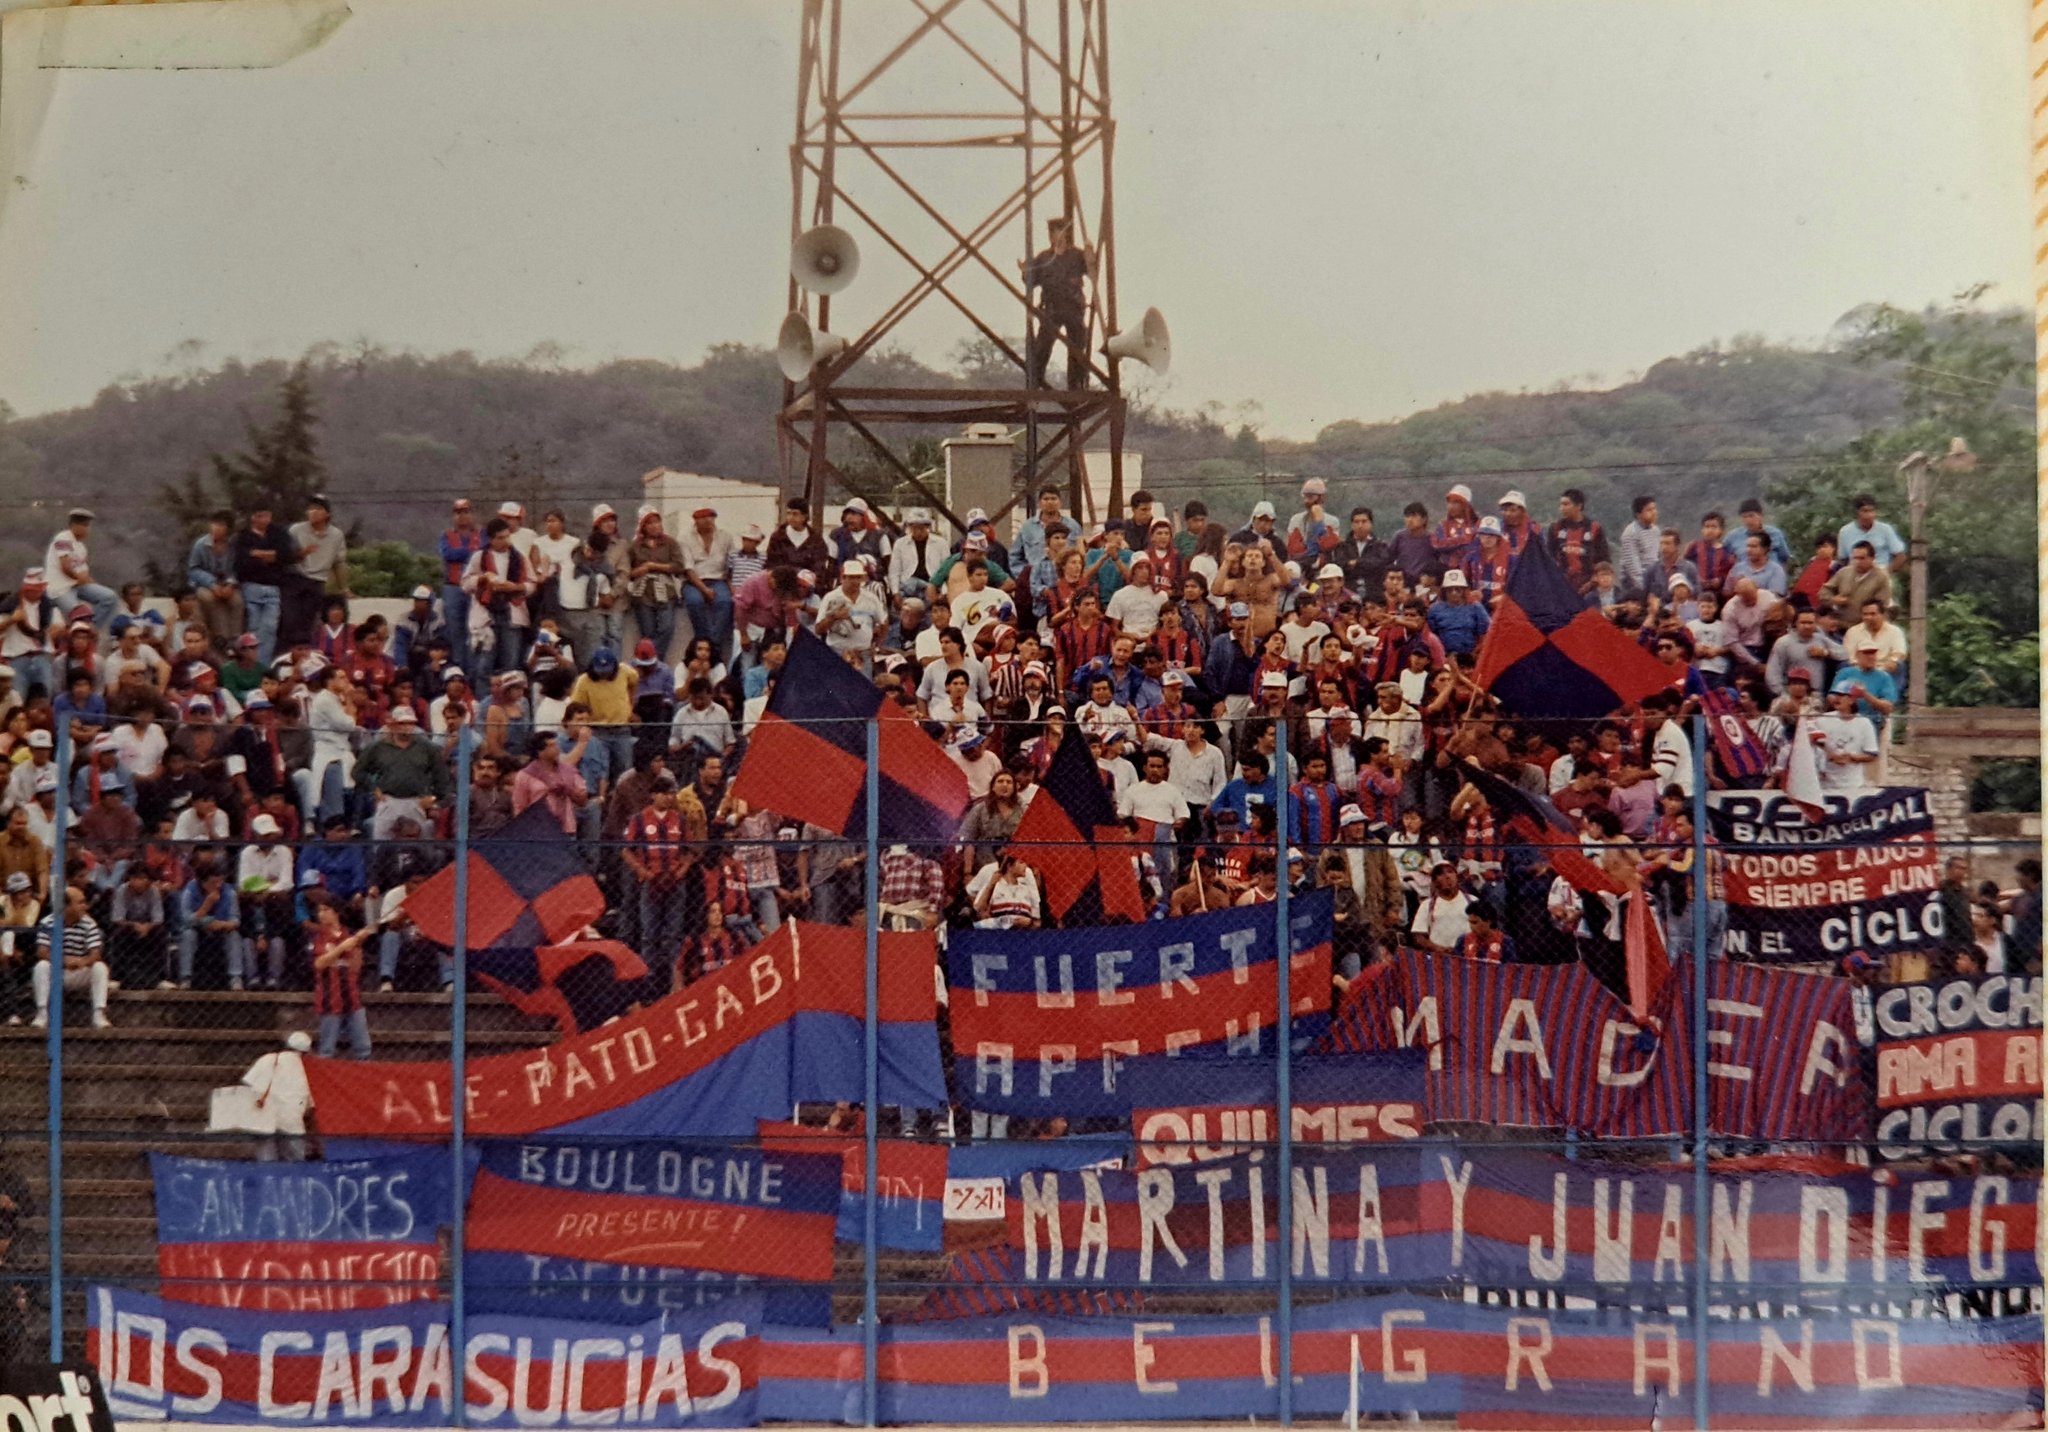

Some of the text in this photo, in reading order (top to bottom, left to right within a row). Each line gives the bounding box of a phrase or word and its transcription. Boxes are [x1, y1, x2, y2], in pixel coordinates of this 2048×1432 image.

[1726, 833, 1924, 879] TODOS LADOS
[1733, 822, 1843, 844] BANDA
[1761, 931, 1792, 954] EL
[1877, 1036, 1976, 1098] AMA
[520, 1145, 784, 1204] BOULOGNE
[1439, 1153, 1473, 1267] Y
[1528, 1171, 1753, 1284] JUAN
